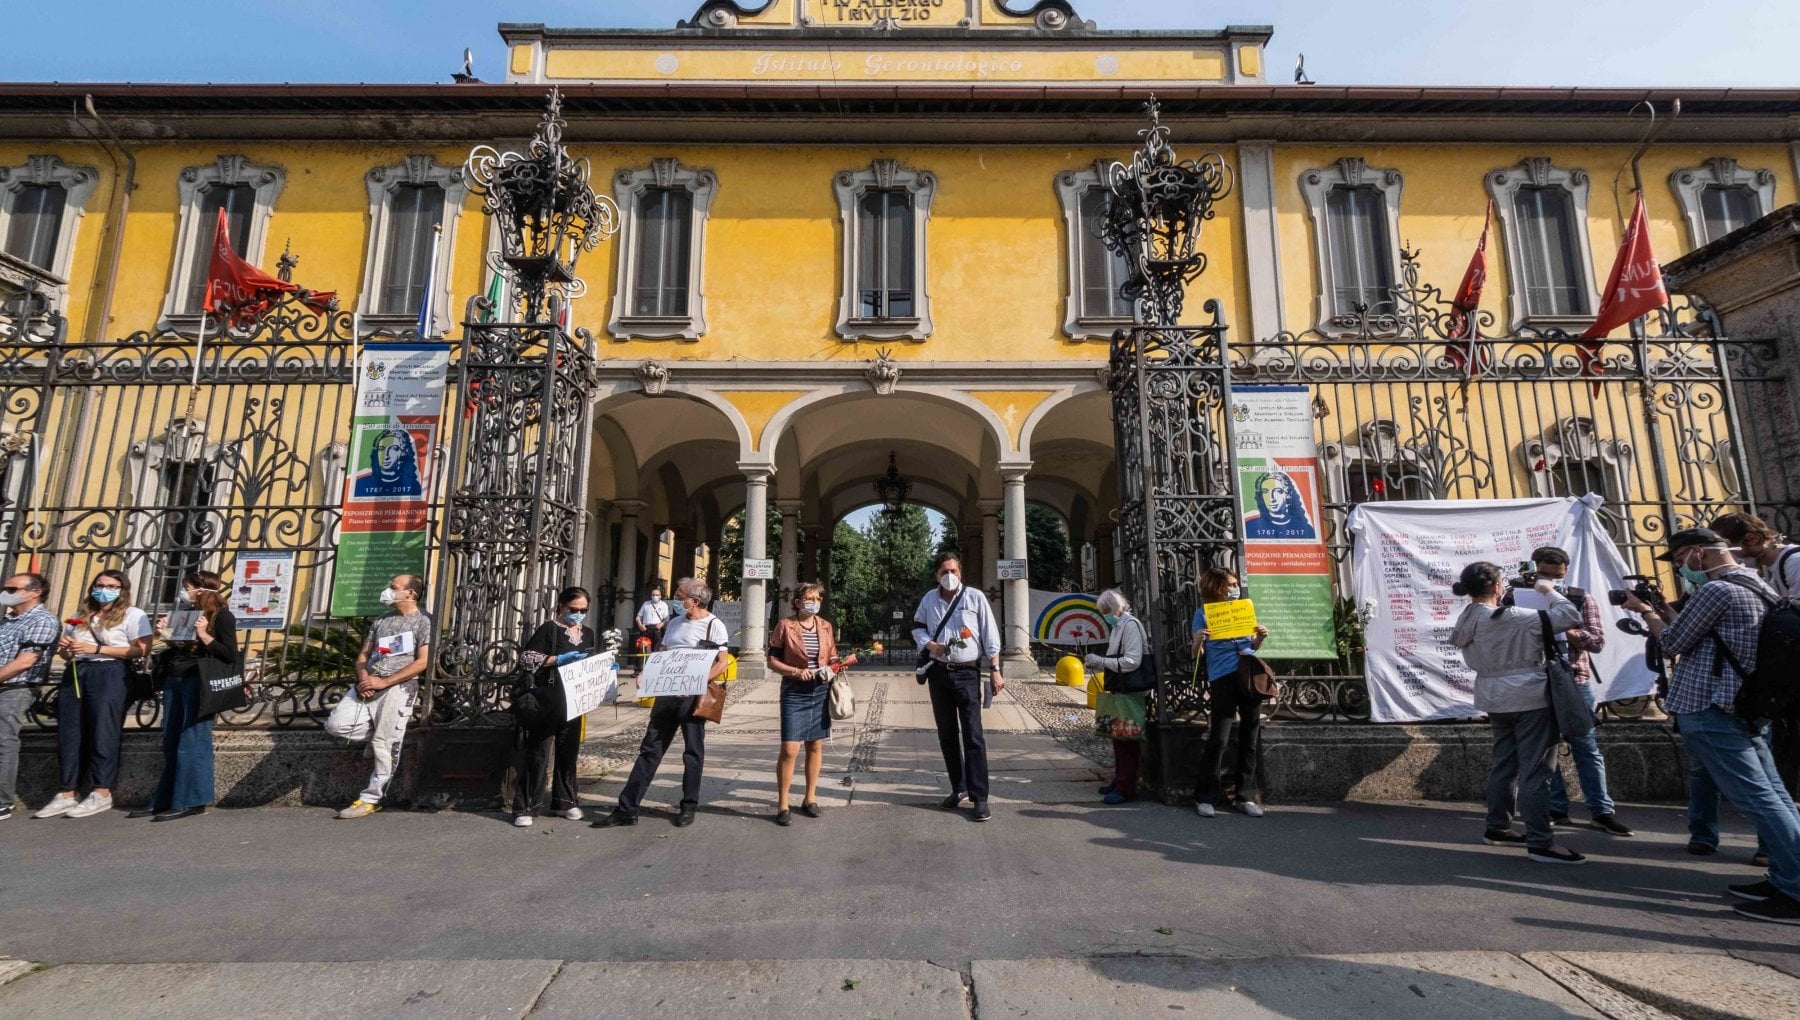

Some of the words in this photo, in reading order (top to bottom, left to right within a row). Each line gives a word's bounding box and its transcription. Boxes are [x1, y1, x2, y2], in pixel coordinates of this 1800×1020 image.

[837, 5, 930, 21] TRIVULZIO
[752, 52, 841, 76] Istituto
[864, 54, 1023, 78] Gerontologico
[644, 675, 705, 694] VEDERMI
